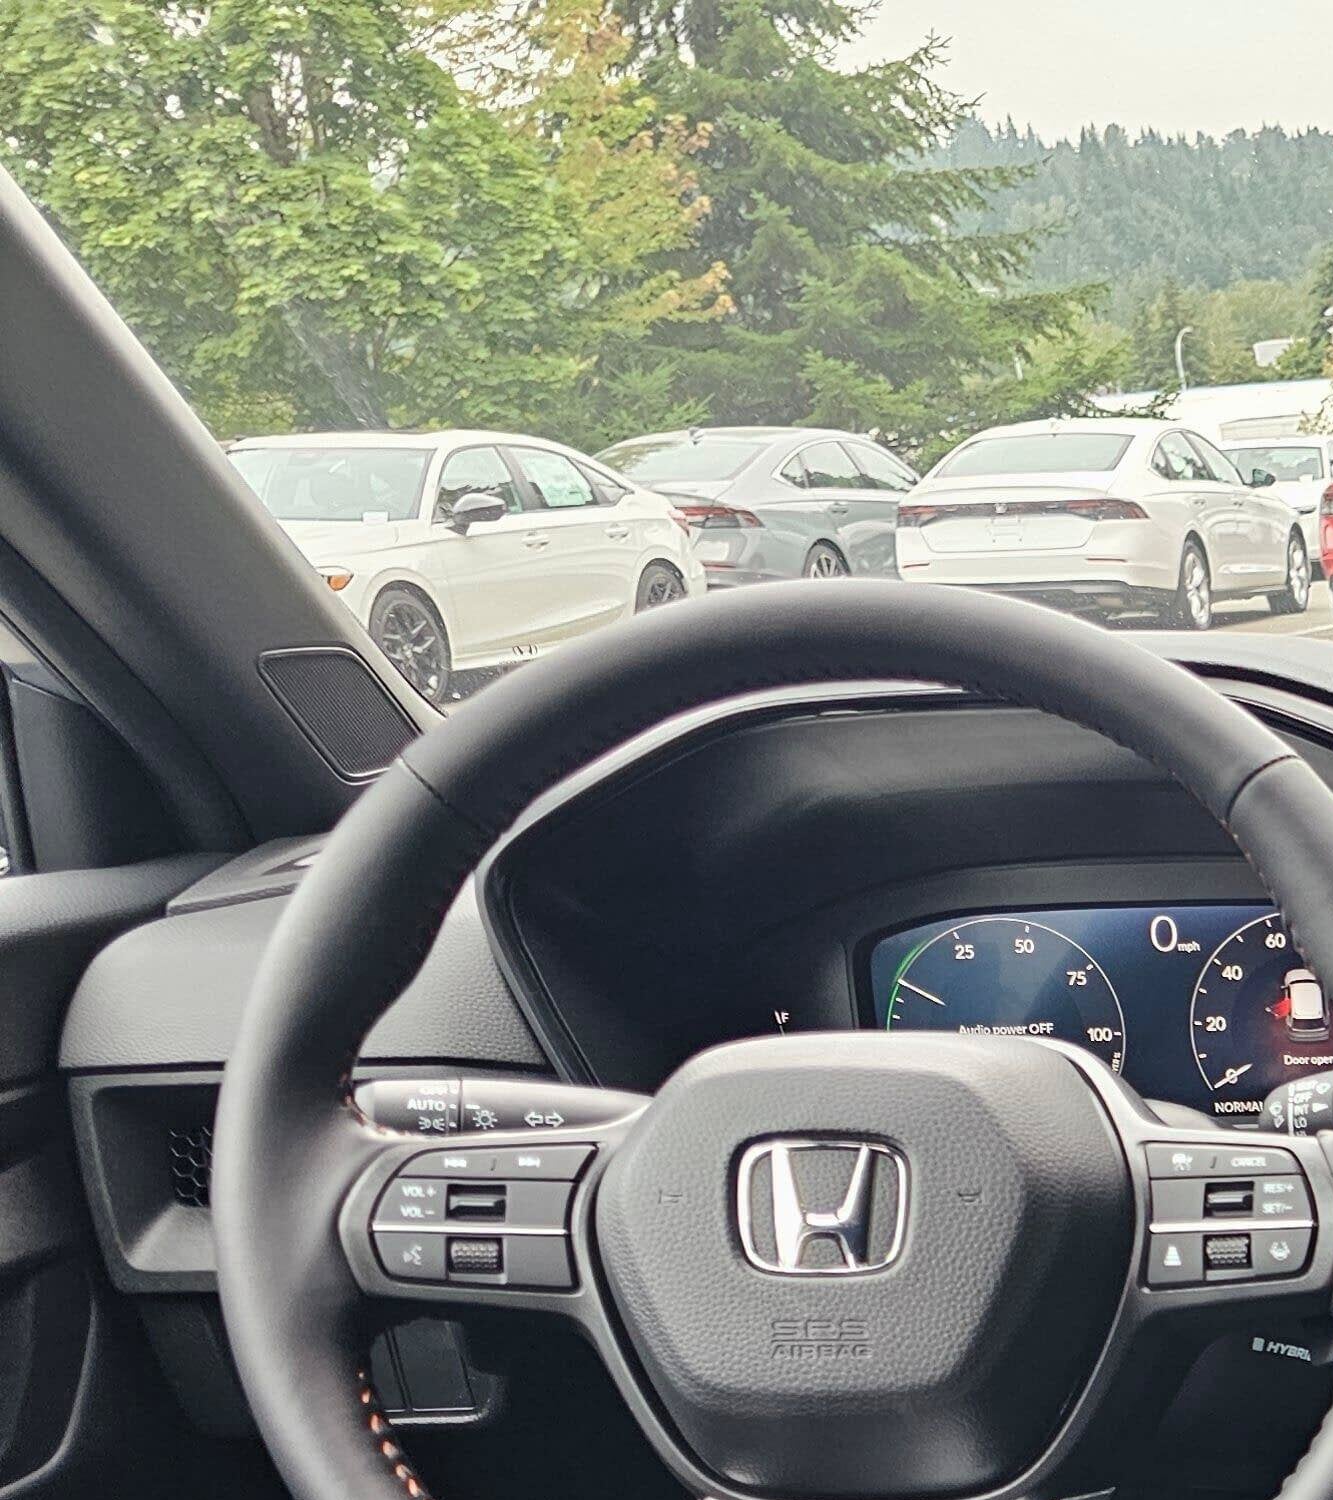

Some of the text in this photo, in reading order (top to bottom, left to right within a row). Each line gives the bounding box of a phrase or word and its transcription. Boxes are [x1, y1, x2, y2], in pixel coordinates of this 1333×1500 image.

[1150, 915, 1200, 954] 0 mph
[1265, 933, 1286, 949] 60
[954, 944, 975, 960] 25
[1014, 939, 1035, 954] 50
[1066, 971, 1088, 986] 75
[1221, 965, 1243, 981] 40
[958, 1023, 1055, 1035] Audio power OFF
[1205, 1016, 1227, 1032] 20
[1087, 1027, 1113, 1042] 100
[1284, 1055, 1309, 1066] Door
[407, 1098, 446, 1111] AUTO
[1231, 1157, 1267, 1167] CANCEL
[771, 1320, 869, 1339] SRS
[770, 1344, 873, 1360] AIRBAG
